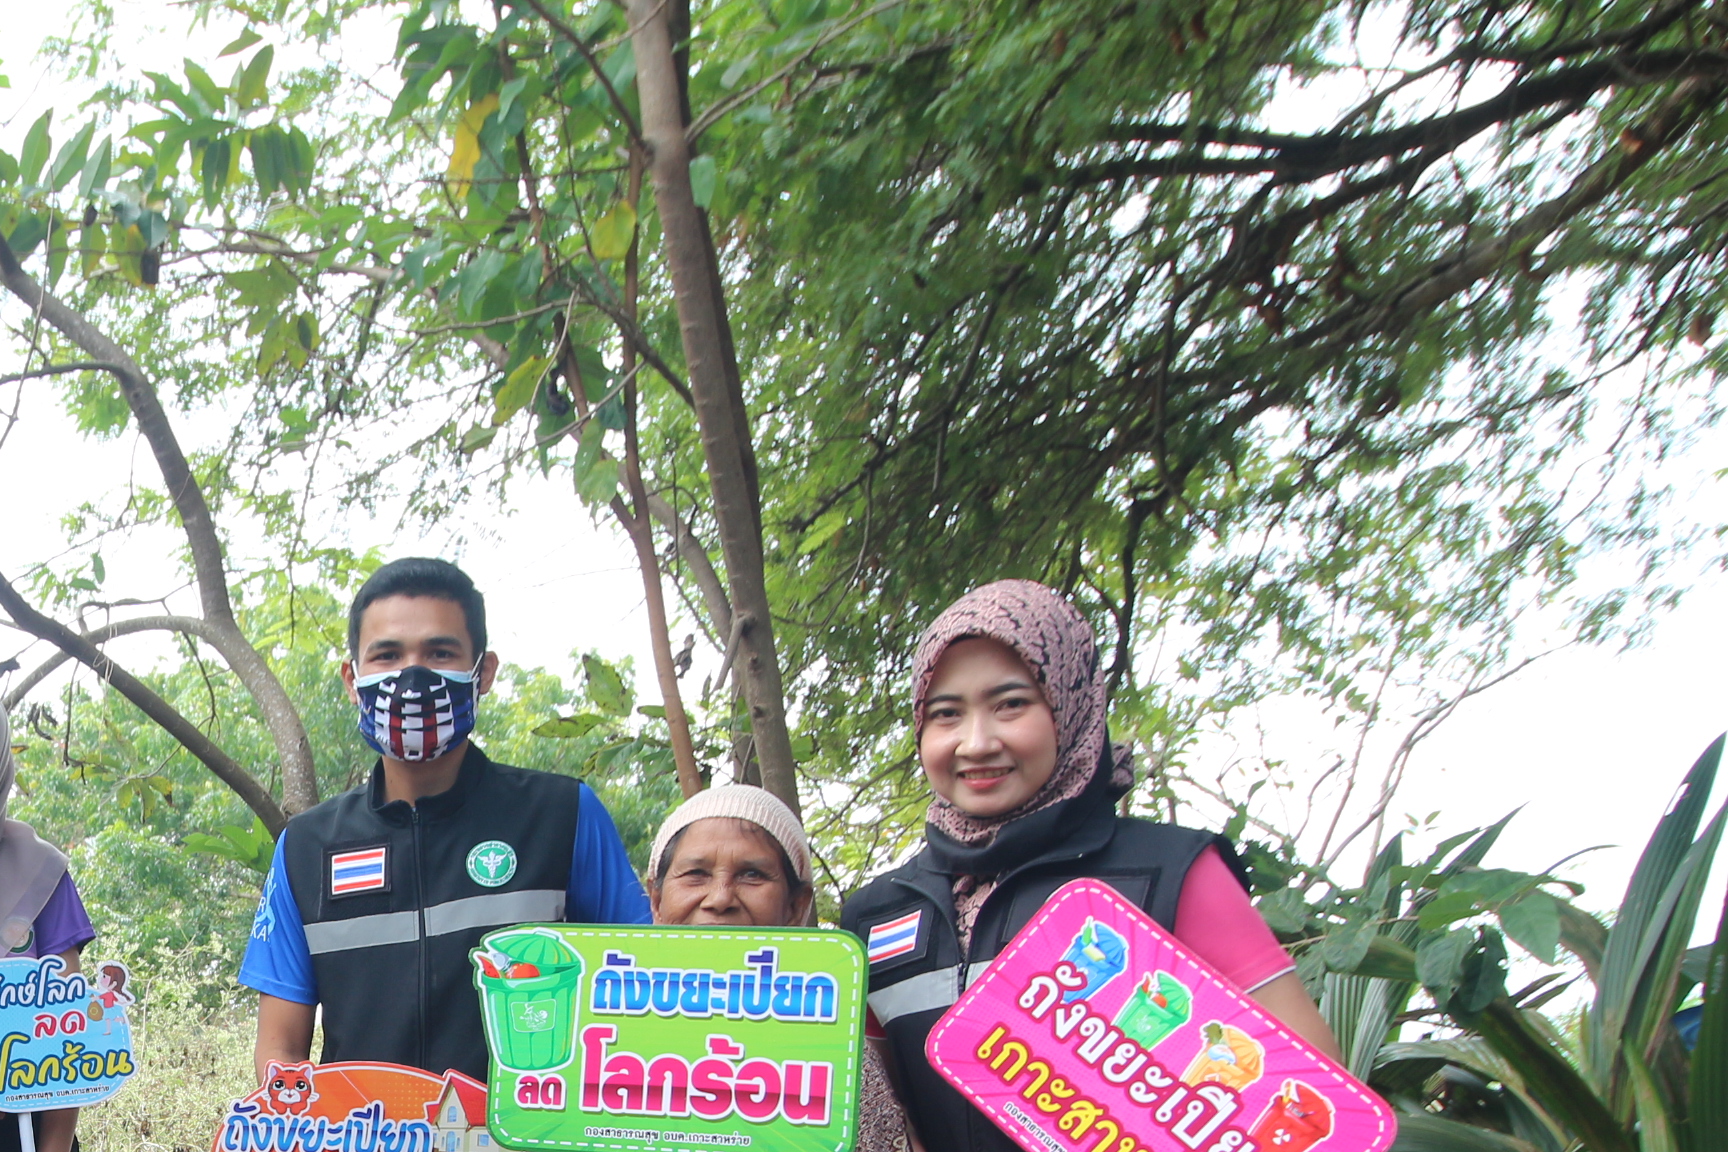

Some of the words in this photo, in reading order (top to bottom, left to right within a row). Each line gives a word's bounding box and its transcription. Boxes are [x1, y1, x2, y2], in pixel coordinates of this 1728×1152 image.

[592, 949, 835, 1018] ถังขยะเปียก
[34, 1011, 86, 1038] ลด
[517, 1073, 563, 1107] ลด
[581, 1027, 831, 1122] โลกร้อน
[585, 1126, 659, 1144] กองสาธารณสุข
[664, 1132, 751, 1146] อบต.เกาะสาหร่าย
